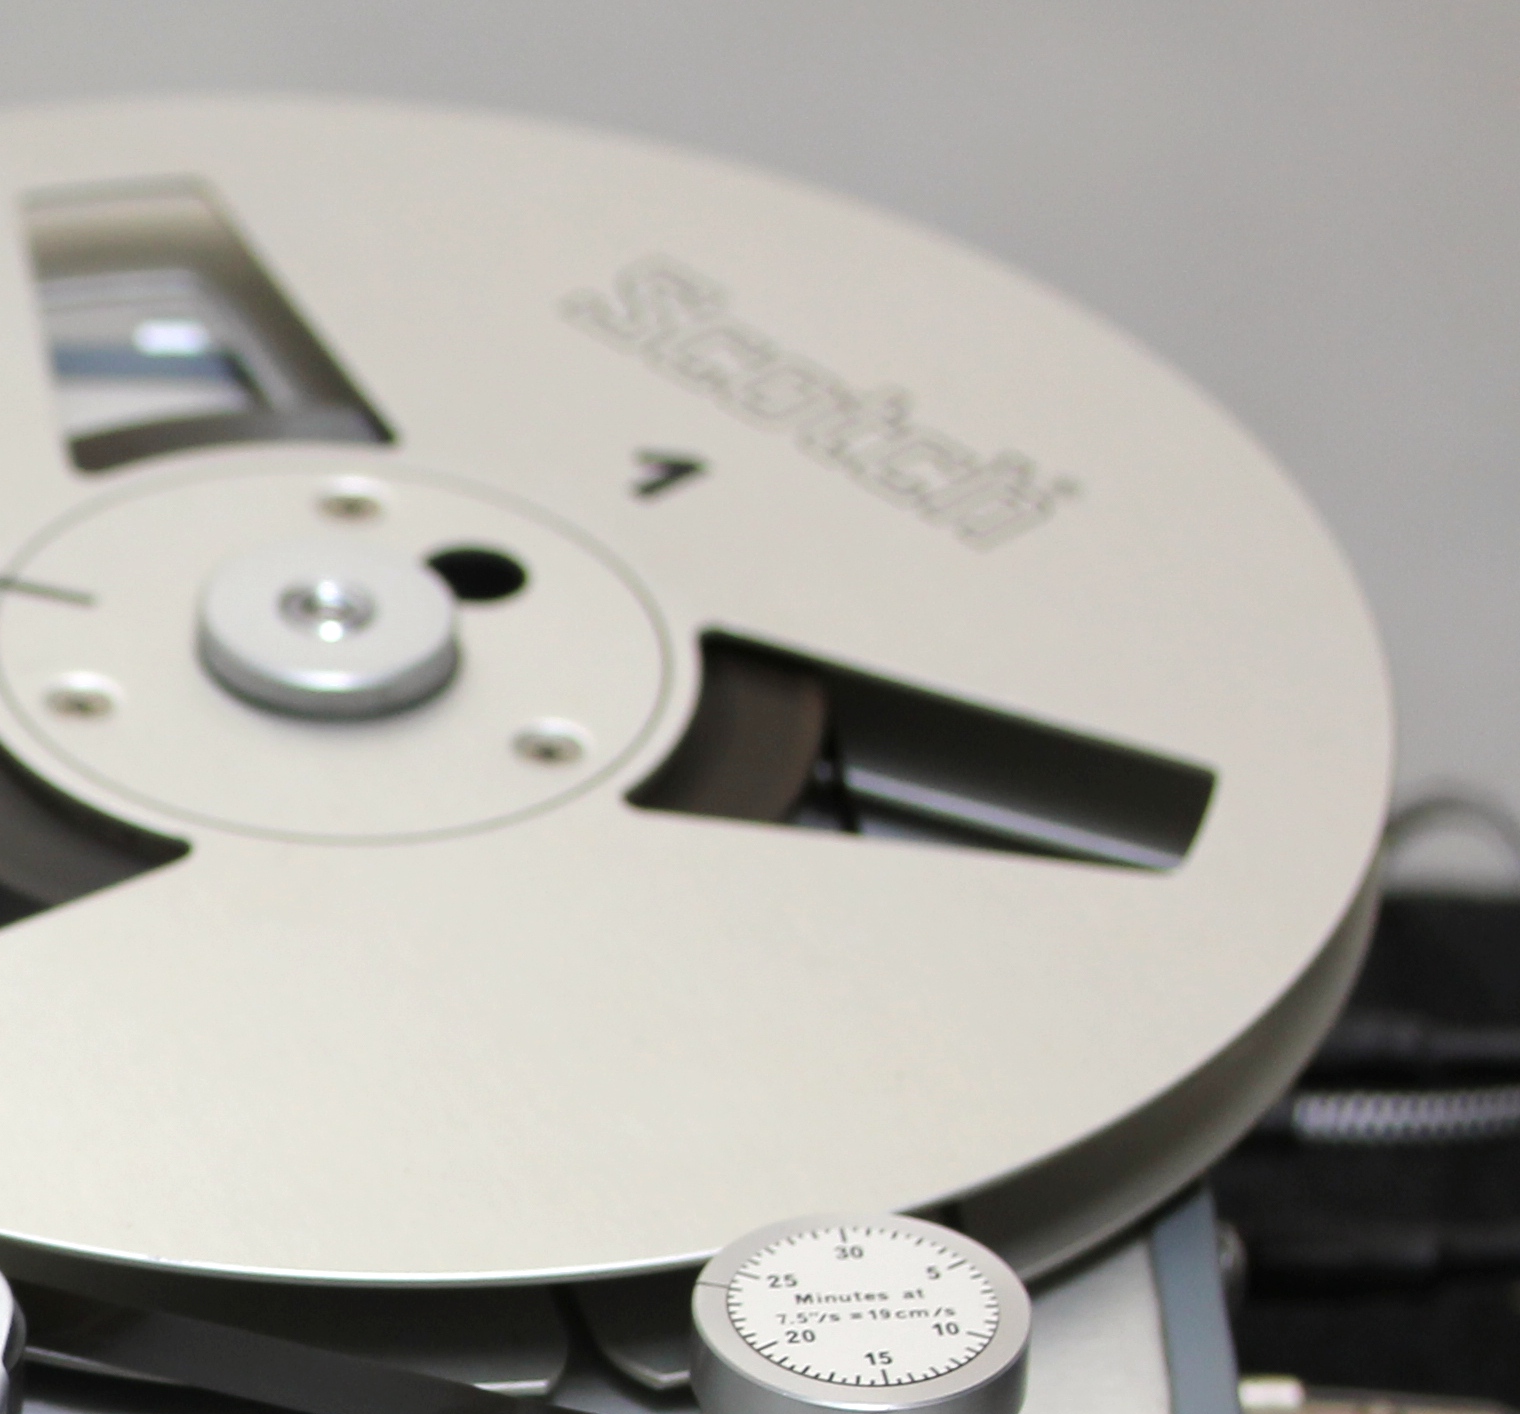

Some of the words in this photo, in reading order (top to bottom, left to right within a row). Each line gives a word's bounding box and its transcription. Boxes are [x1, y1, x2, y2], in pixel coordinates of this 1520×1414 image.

[836, 1246, 863, 1259] 30
[926, 1265, 941, 1280] 5
[767, 1274, 797, 1288] 25
[796, 1290, 889, 1304] Minutes
[903, 1289, 925, 1300] at
[932, 1322, 959, 1336] 10
[785, 1330, 815, 1344] 20
[865, 1352, 893, 1366] 15
